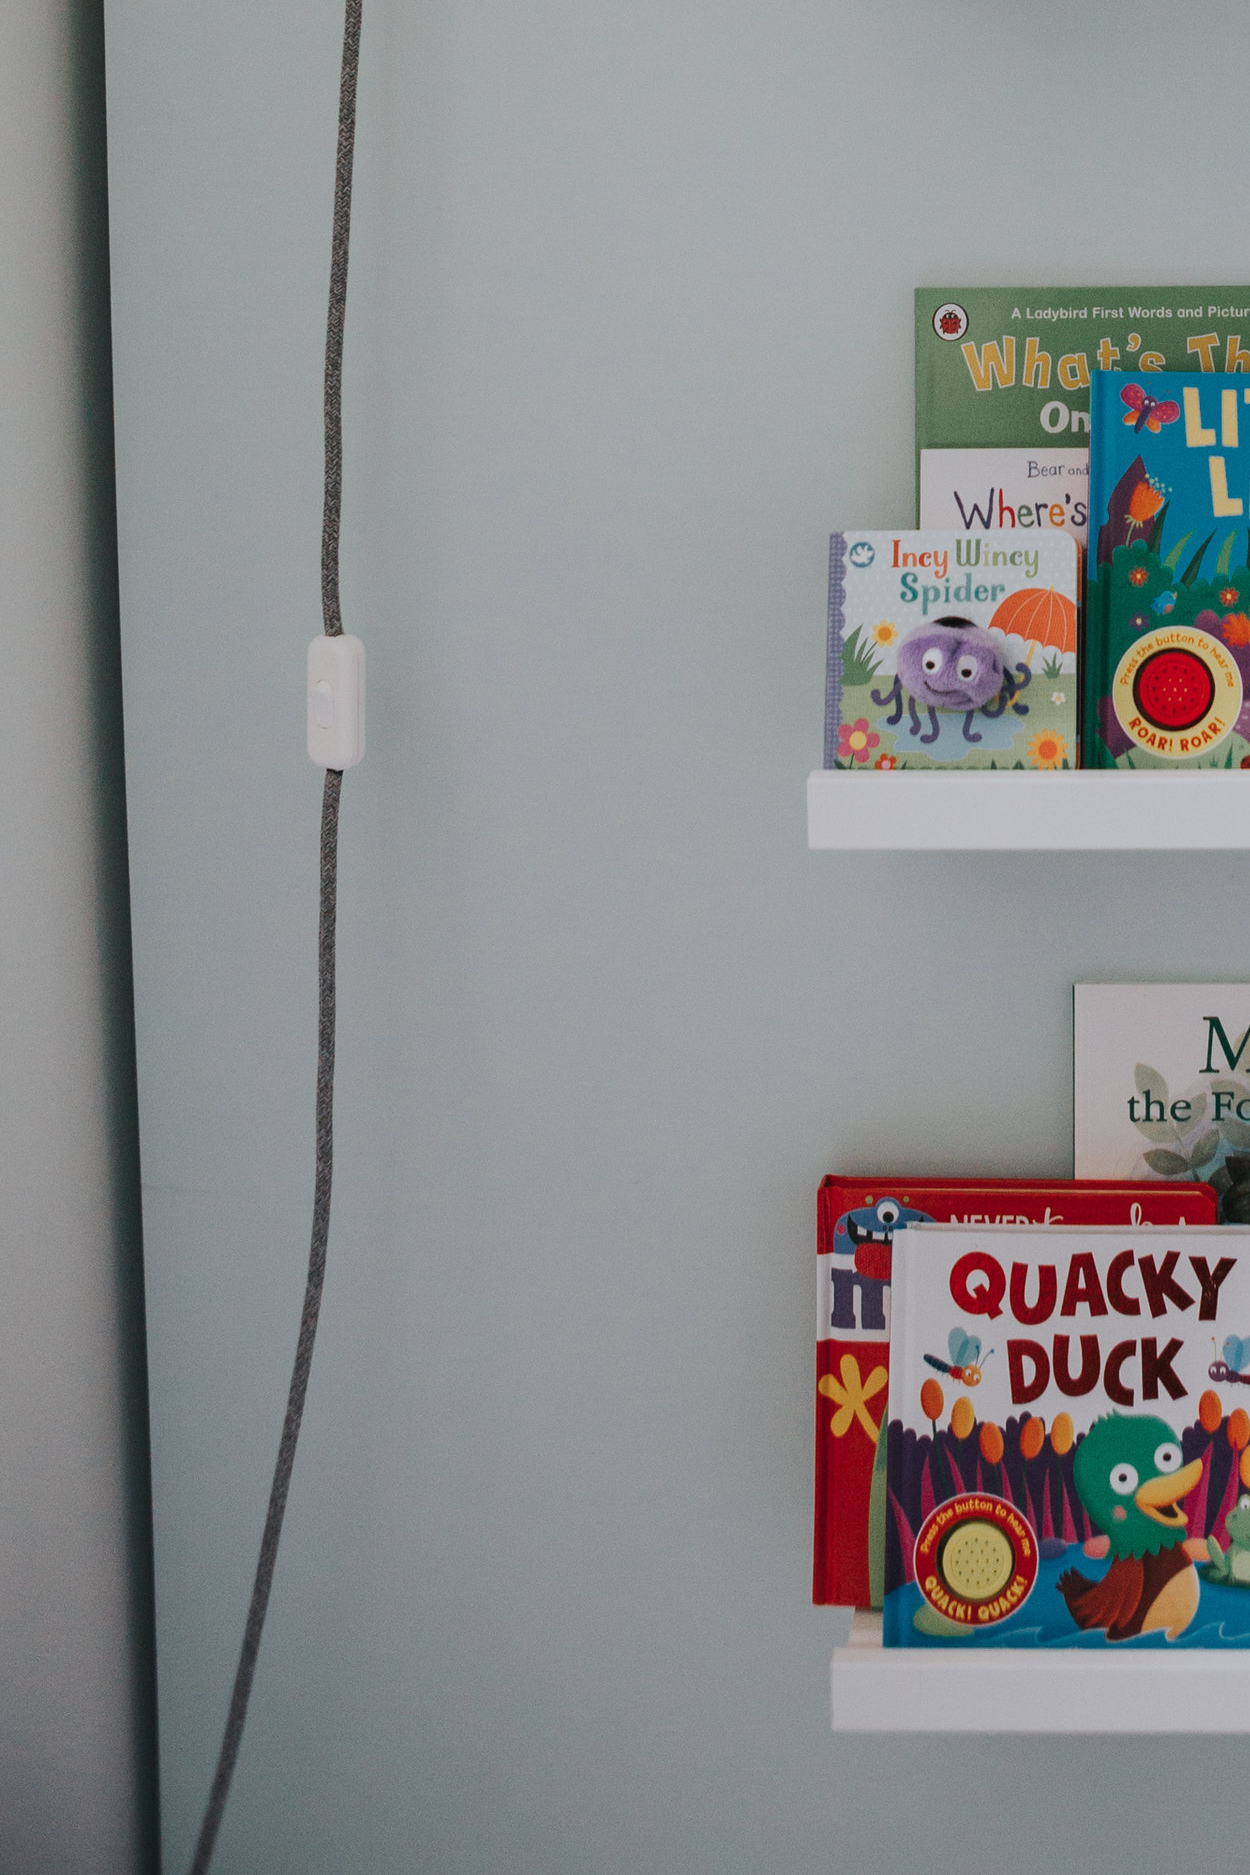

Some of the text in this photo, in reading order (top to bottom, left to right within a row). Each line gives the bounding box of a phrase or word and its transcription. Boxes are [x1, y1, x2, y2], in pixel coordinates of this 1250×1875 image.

[1011, 308, 1022, 319] A
[1026, 307, 1087, 322] Ladybird
[1092, 307, 1124, 319] First
[1128, 306, 1173, 319] Words
[1177, 306, 1203, 318] and
[961, 332, 1166, 391] What's
[1027, 461, 1065, 478] Bear
[954, 487, 1087, 530] Where's
[891, 538, 1039, 579] Incy Wincy
[900, 572, 1005, 615] Spider
[1120, 633, 1234, 688] Press the button to hear me
[1129, 716, 1226, 752] ROAR! ROAR!
[1127, 1089, 1192, 1122] the
[949, 1249, 1238, 1325] QUACKY
[1006, 1334, 1189, 1407] DUCK
[920, 1499, 1031, 1557] Press the button to hear me
[925, 1575, 1028, 1621] QUACK! QUACK!
